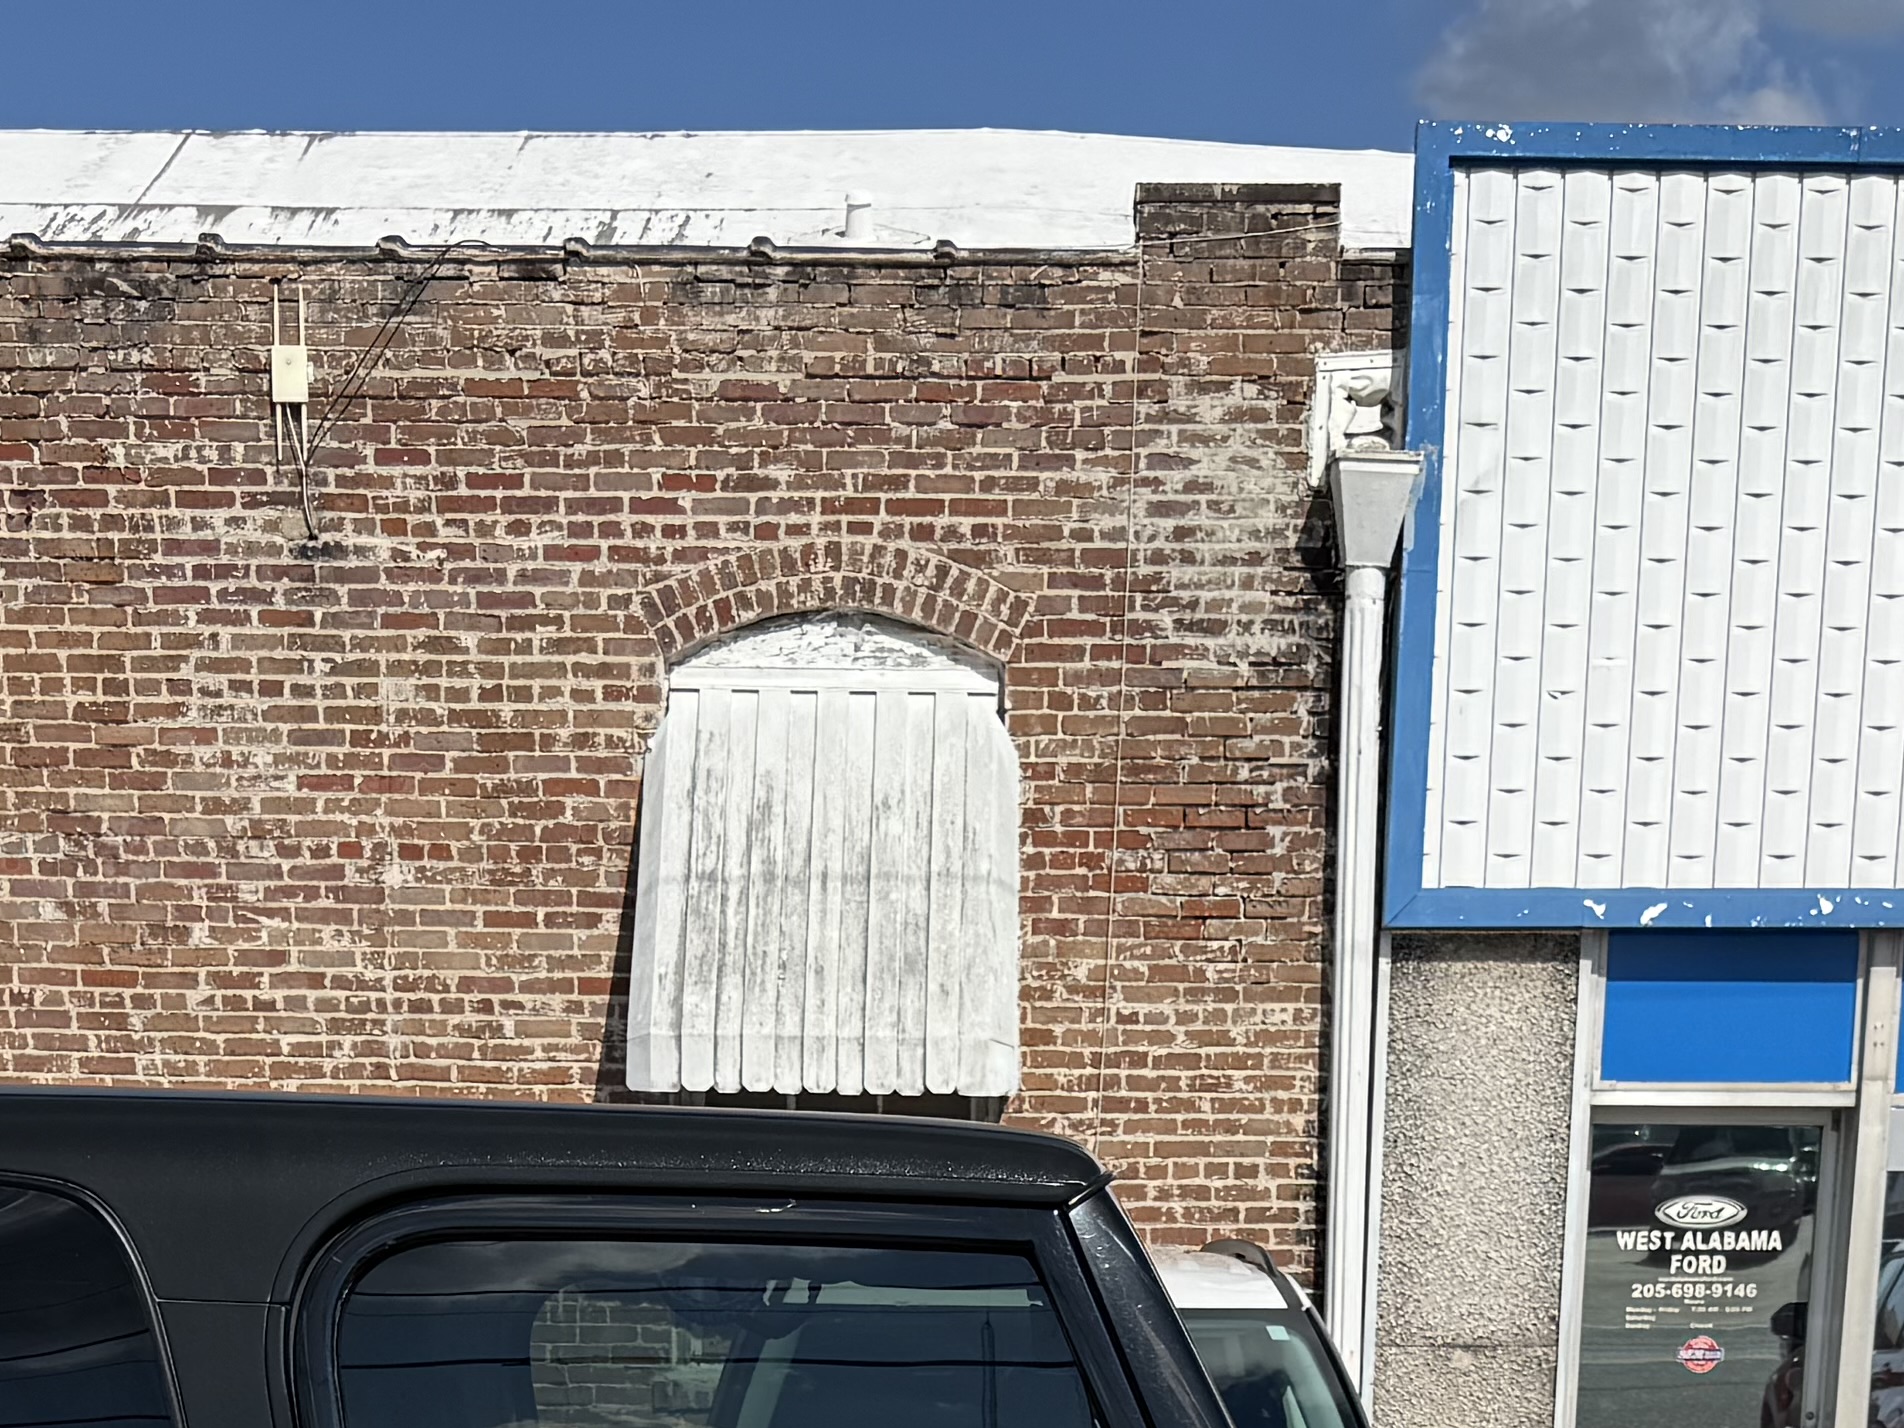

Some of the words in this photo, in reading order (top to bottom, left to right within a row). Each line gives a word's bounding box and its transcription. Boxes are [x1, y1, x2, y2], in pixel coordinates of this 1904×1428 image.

[1677, 1201, 1725, 1220] Ford
[1616, 1230, 1676, 1251] WEST
[1680, 1230, 1783, 1251] ALABAMA
[1669, 1254, 1727, 1275] FORD
